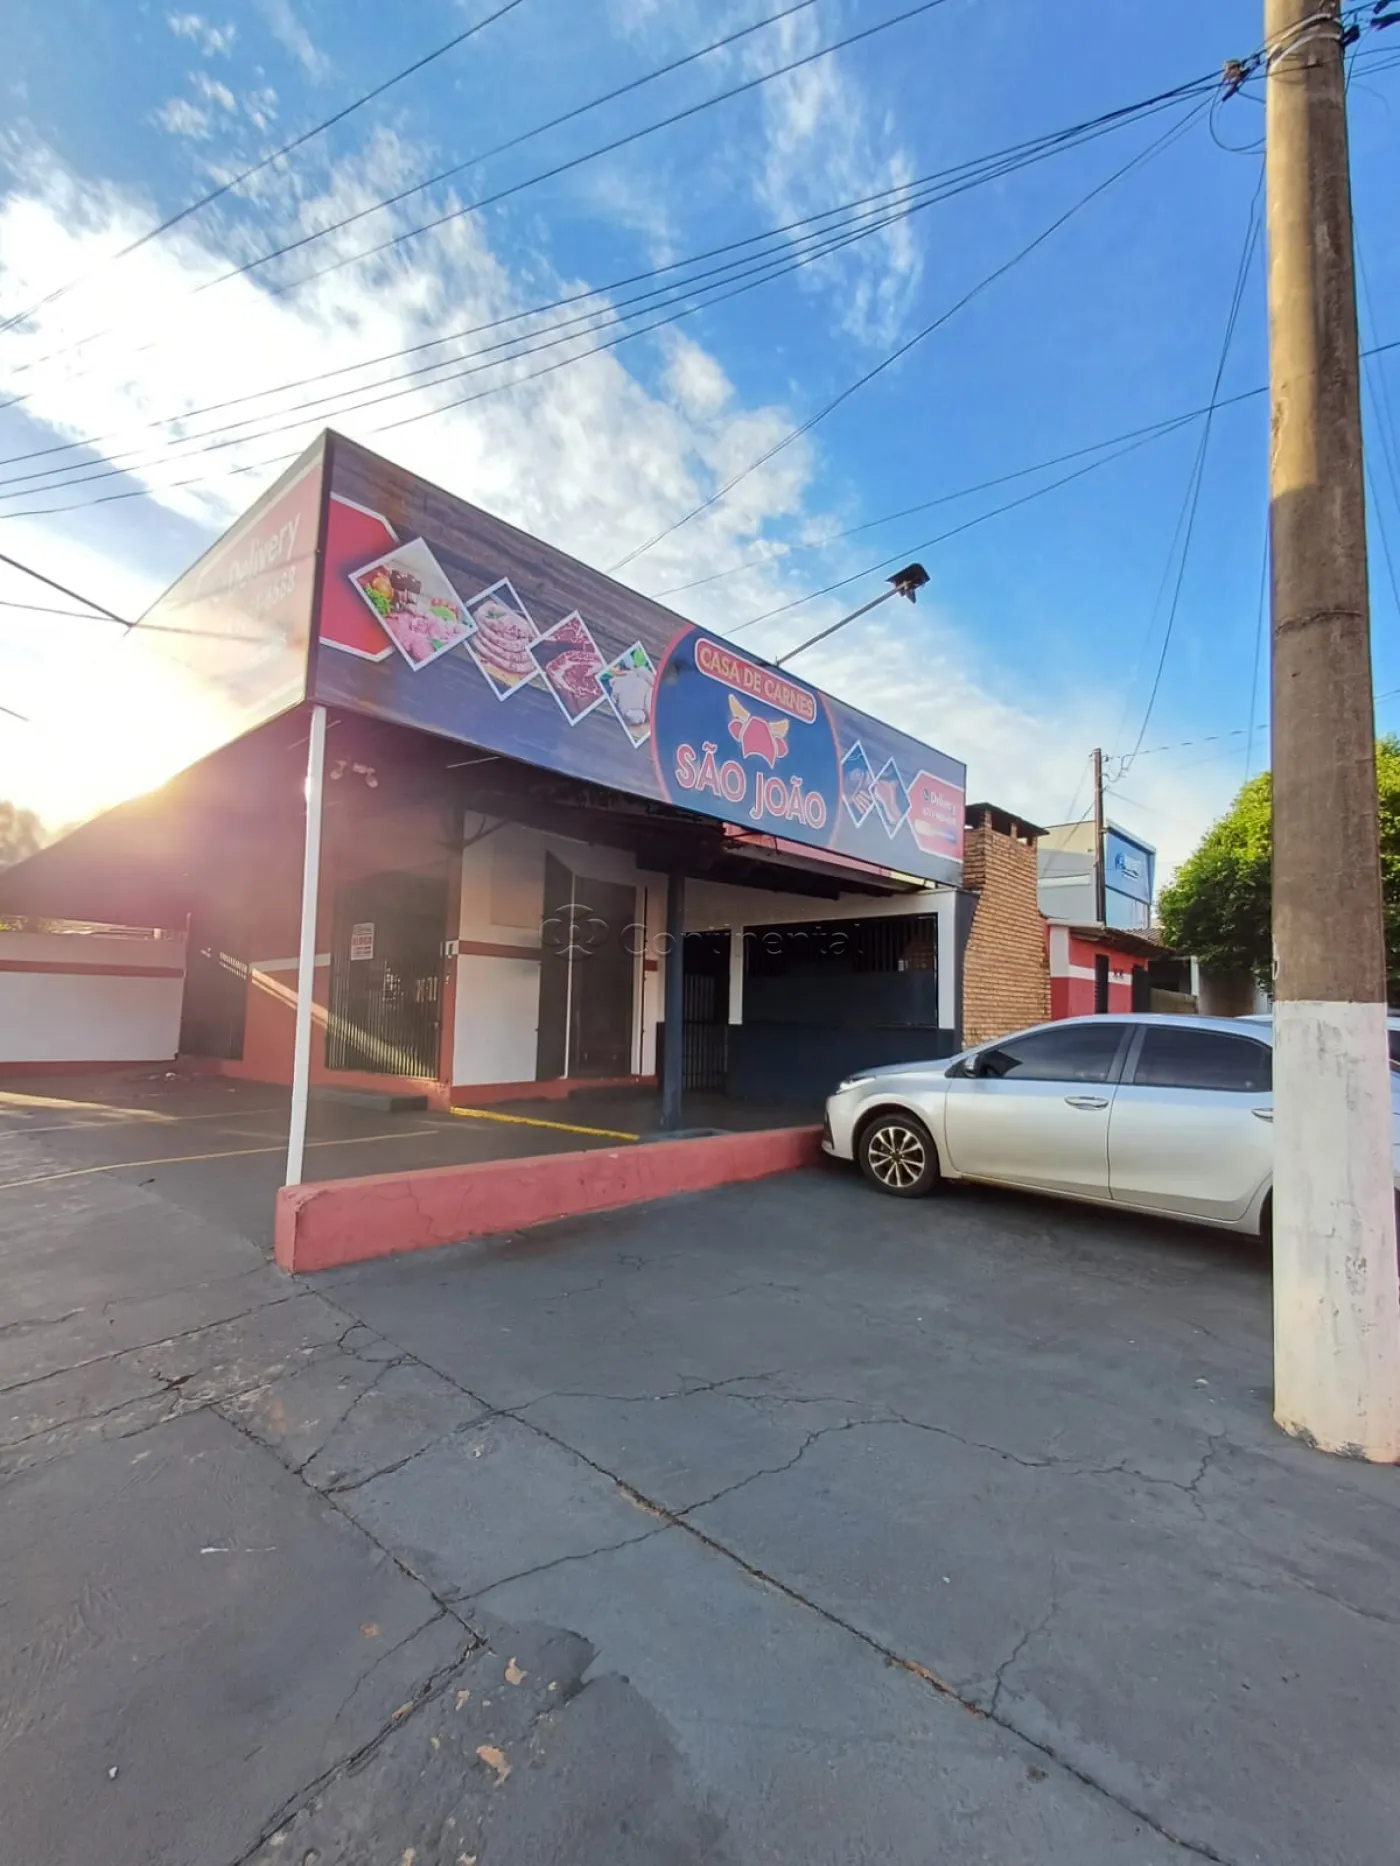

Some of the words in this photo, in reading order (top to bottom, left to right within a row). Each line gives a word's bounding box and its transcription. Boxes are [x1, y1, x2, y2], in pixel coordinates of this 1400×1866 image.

[228, 512, 301, 594] Delivery
[699, 646, 741, 687] CASA
[743, 668, 762, 694] DE
[764, 679, 814, 720] CARNES
[675, 741, 747, 803] SÃO
[749, 771, 827, 830] JOÃO
